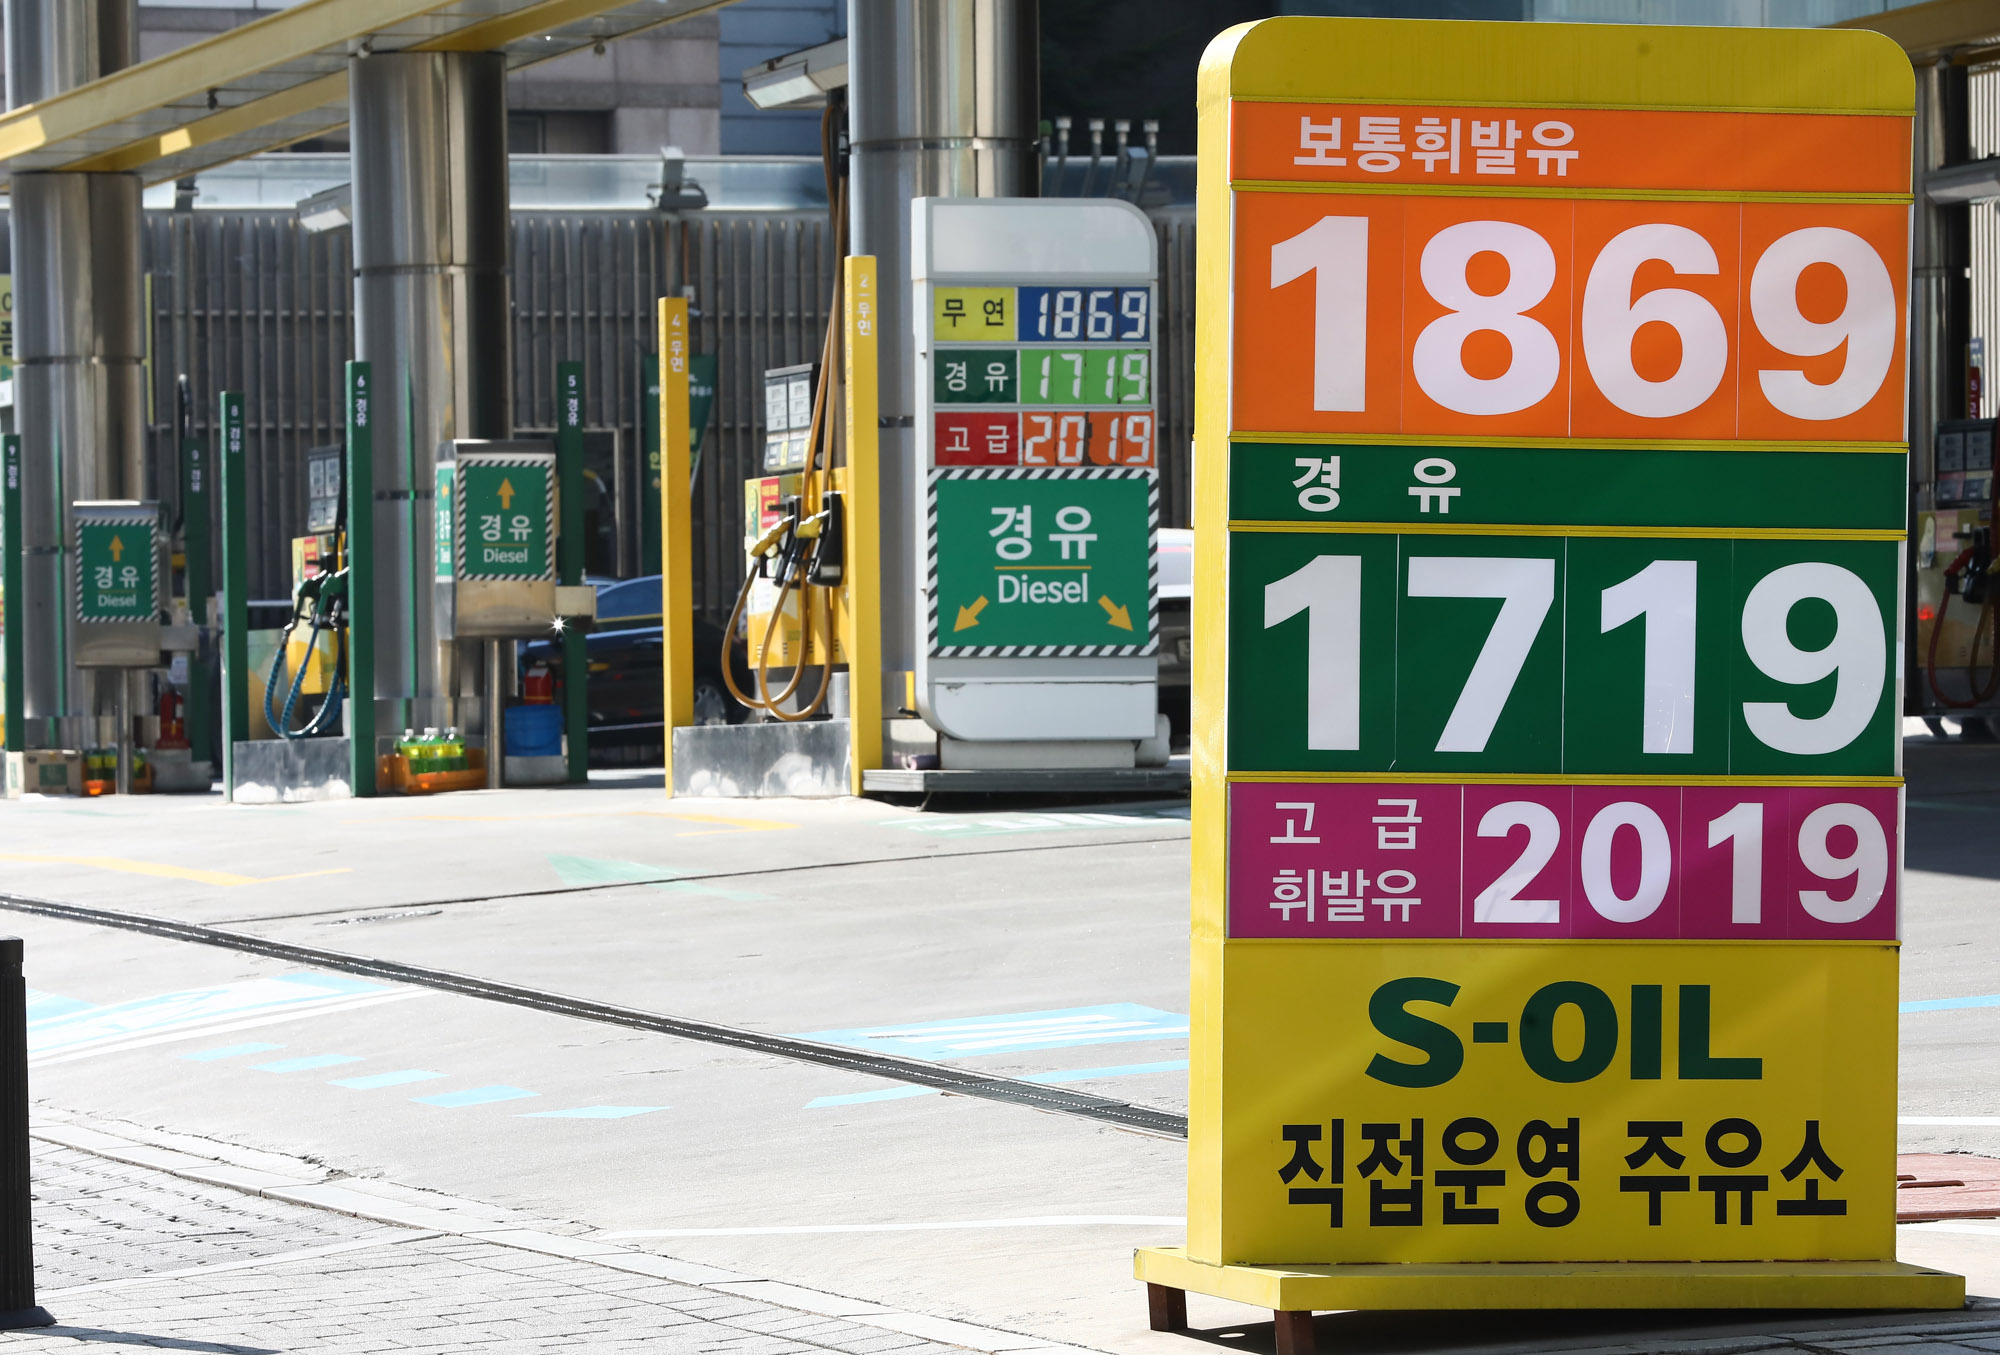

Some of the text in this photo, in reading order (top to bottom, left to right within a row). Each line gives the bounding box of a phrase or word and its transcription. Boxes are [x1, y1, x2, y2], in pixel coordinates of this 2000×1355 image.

[1293, 116, 1579, 177] 보통휘발유
[859, 273, 869, 288] 2
[671, 314, 681, 327] 4
[1038, 290, 1148, 339] 1869
[1270, 215, 1897, 421] 1869
[357, 375, 366, 388] 6
[568, 374, 577, 387] 5
[1039, 353, 1149, 402] 1719
[1024, 415, 1152, 464] 2019
[483, 547, 528, 563] Diesel
[988, 504, 1098, 561] 경유
[98, 594, 137, 607] Diesel
[997, 572, 1089, 604] Diesel
[1264, 555, 1887, 756] 1719
[1473, 800, 1890, 925] 2019
[1269, 868, 1422, 923] 휘발유
[1364, 975, 1763, 1088] S-OIL
[1278, 1116, 1848, 1230] 직접운영 주유소
